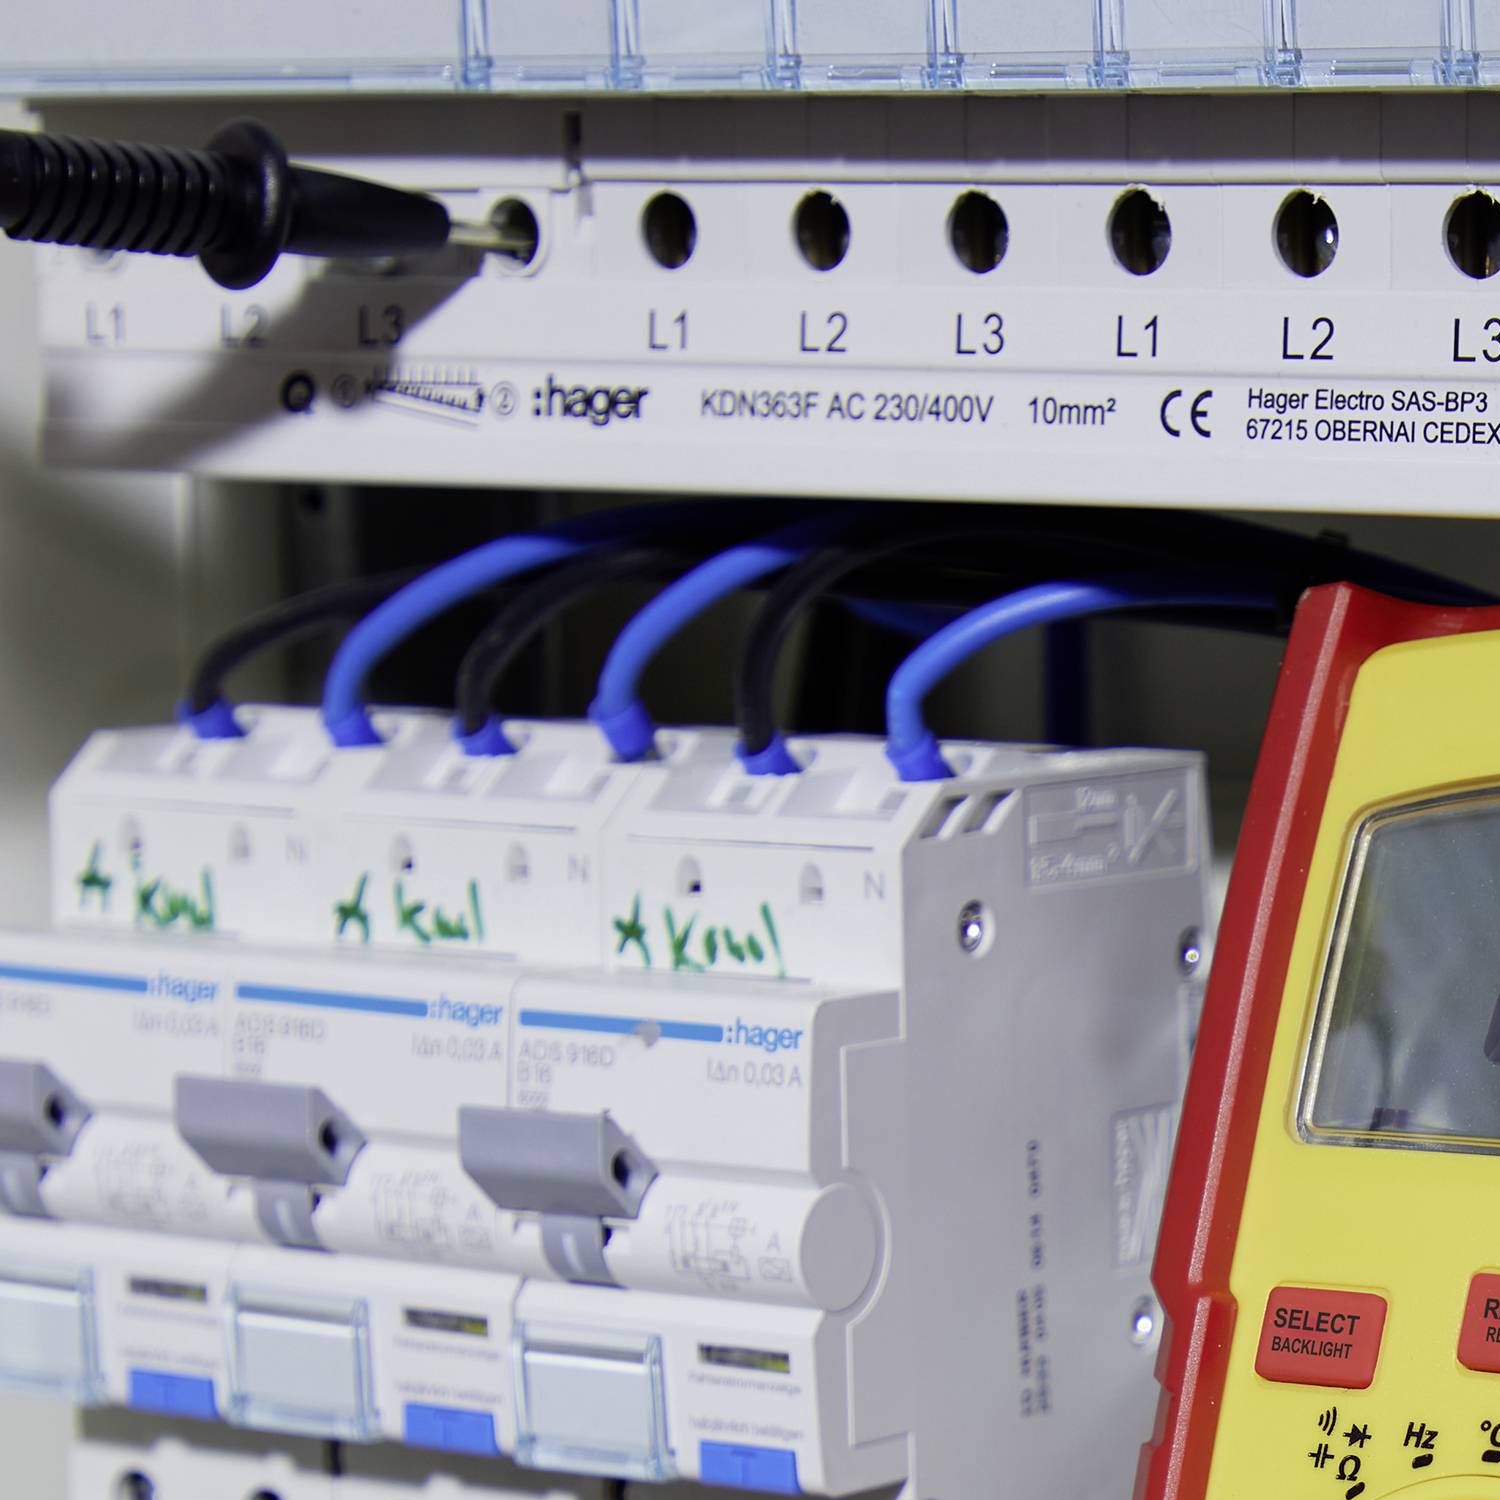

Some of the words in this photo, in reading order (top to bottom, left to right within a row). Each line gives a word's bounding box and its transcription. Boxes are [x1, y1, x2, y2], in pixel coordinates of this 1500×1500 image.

[86, 305, 126, 342] L1
[220, 306, 268, 347] L2
[358, 307, 405, 347] L3
[649, 310, 689, 350] L1
[800, 311, 848, 353] L2
[956, 313, 1005, 355] L3
[1116, 315, 1159, 358] L1
[1282, 317, 1335, 360] L2
[701, 388, 819, 421] KDN363F
[827, 390, 865, 421] AC
[874, 392, 994, 424] 230/400V
[1247, 387, 1309, 417] Hager
[1315, 388, 1385, 413] Electro
[1391, 389, 1488, 414] SAS-BP3
[1246, 418, 1308, 442] 67215
[1315, 420, 1416, 444] OBERNAI
[864, 871, 886, 900] N
[1273, 1307, 1360, 1337] SELECT
[1271, 1335, 1353, 1360] BACKLIGHT
[1403, 1422, 1439, 1450] Hz
